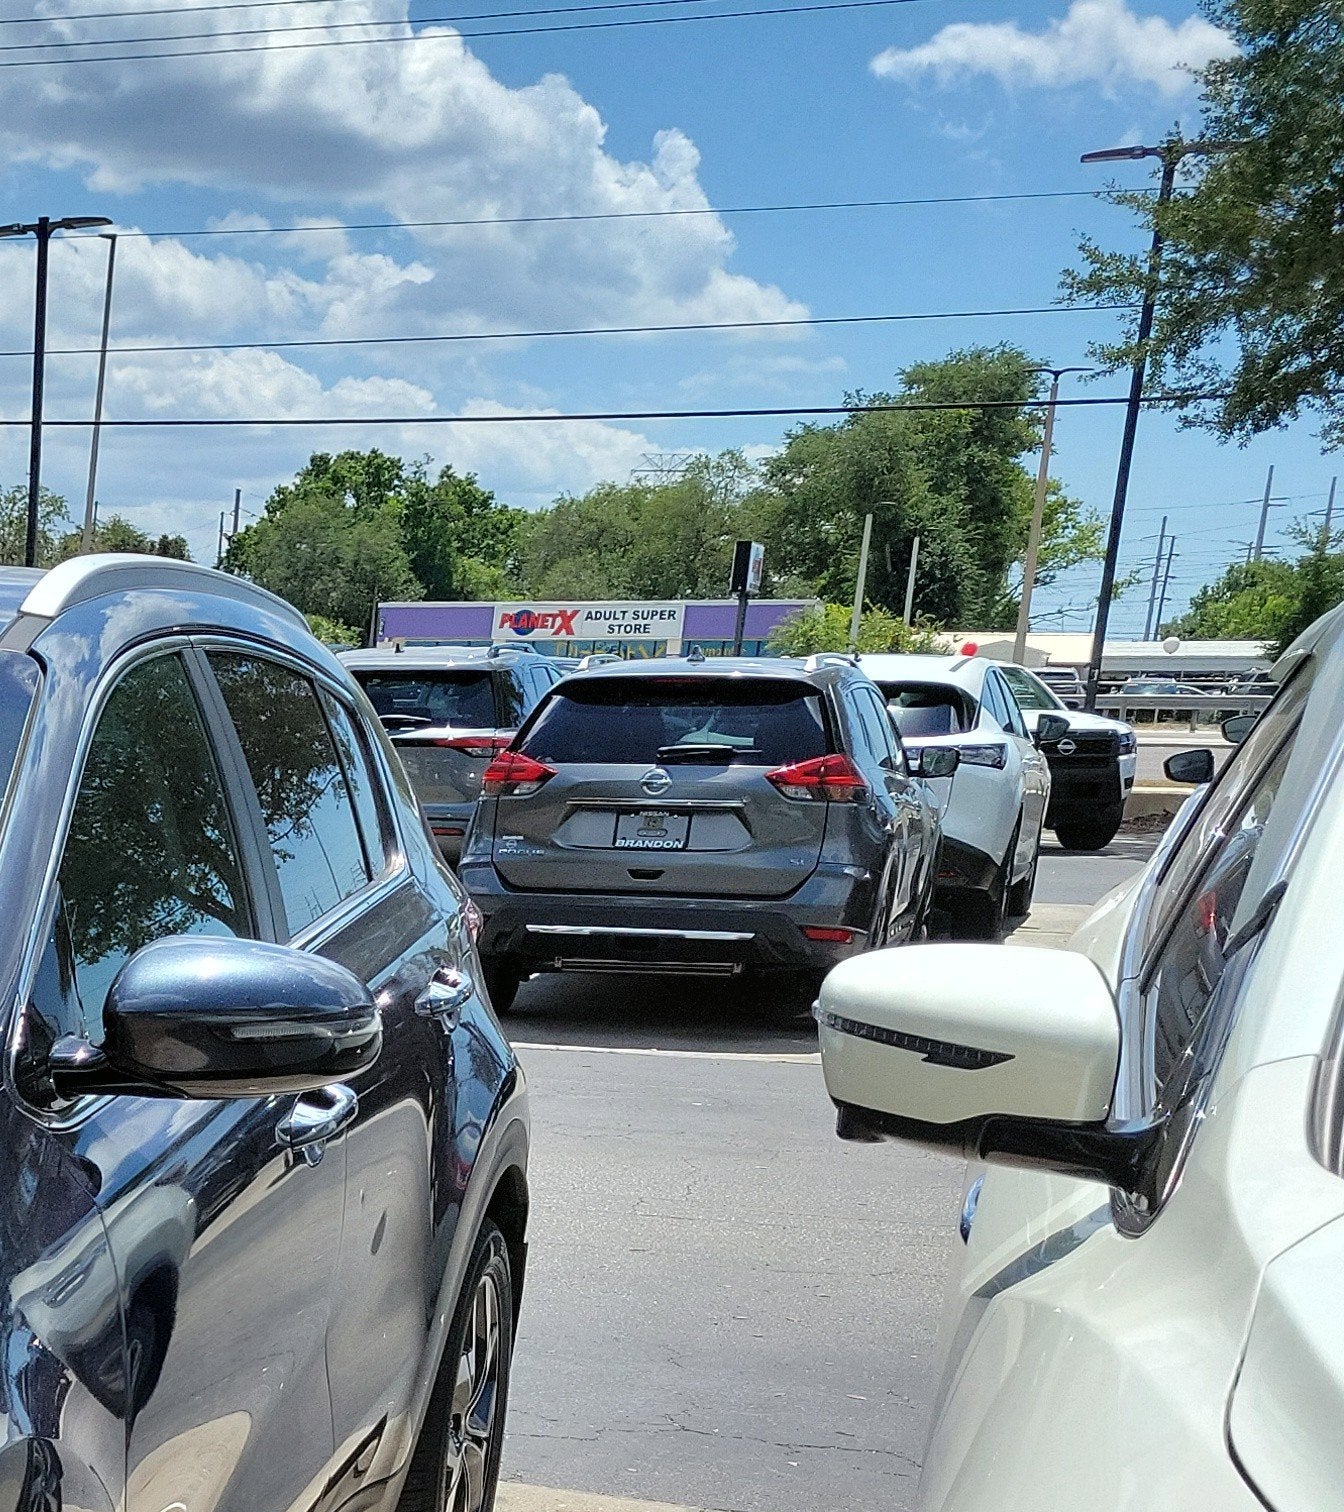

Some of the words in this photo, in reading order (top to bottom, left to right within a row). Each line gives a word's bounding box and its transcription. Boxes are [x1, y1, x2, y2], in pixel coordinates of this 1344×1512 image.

[585, 609, 629, 621] ADULT
[632, 610, 677, 621] SUPER
[607, 623, 651, 635] STORE
[615, 839, 684, 849] BRANDON
